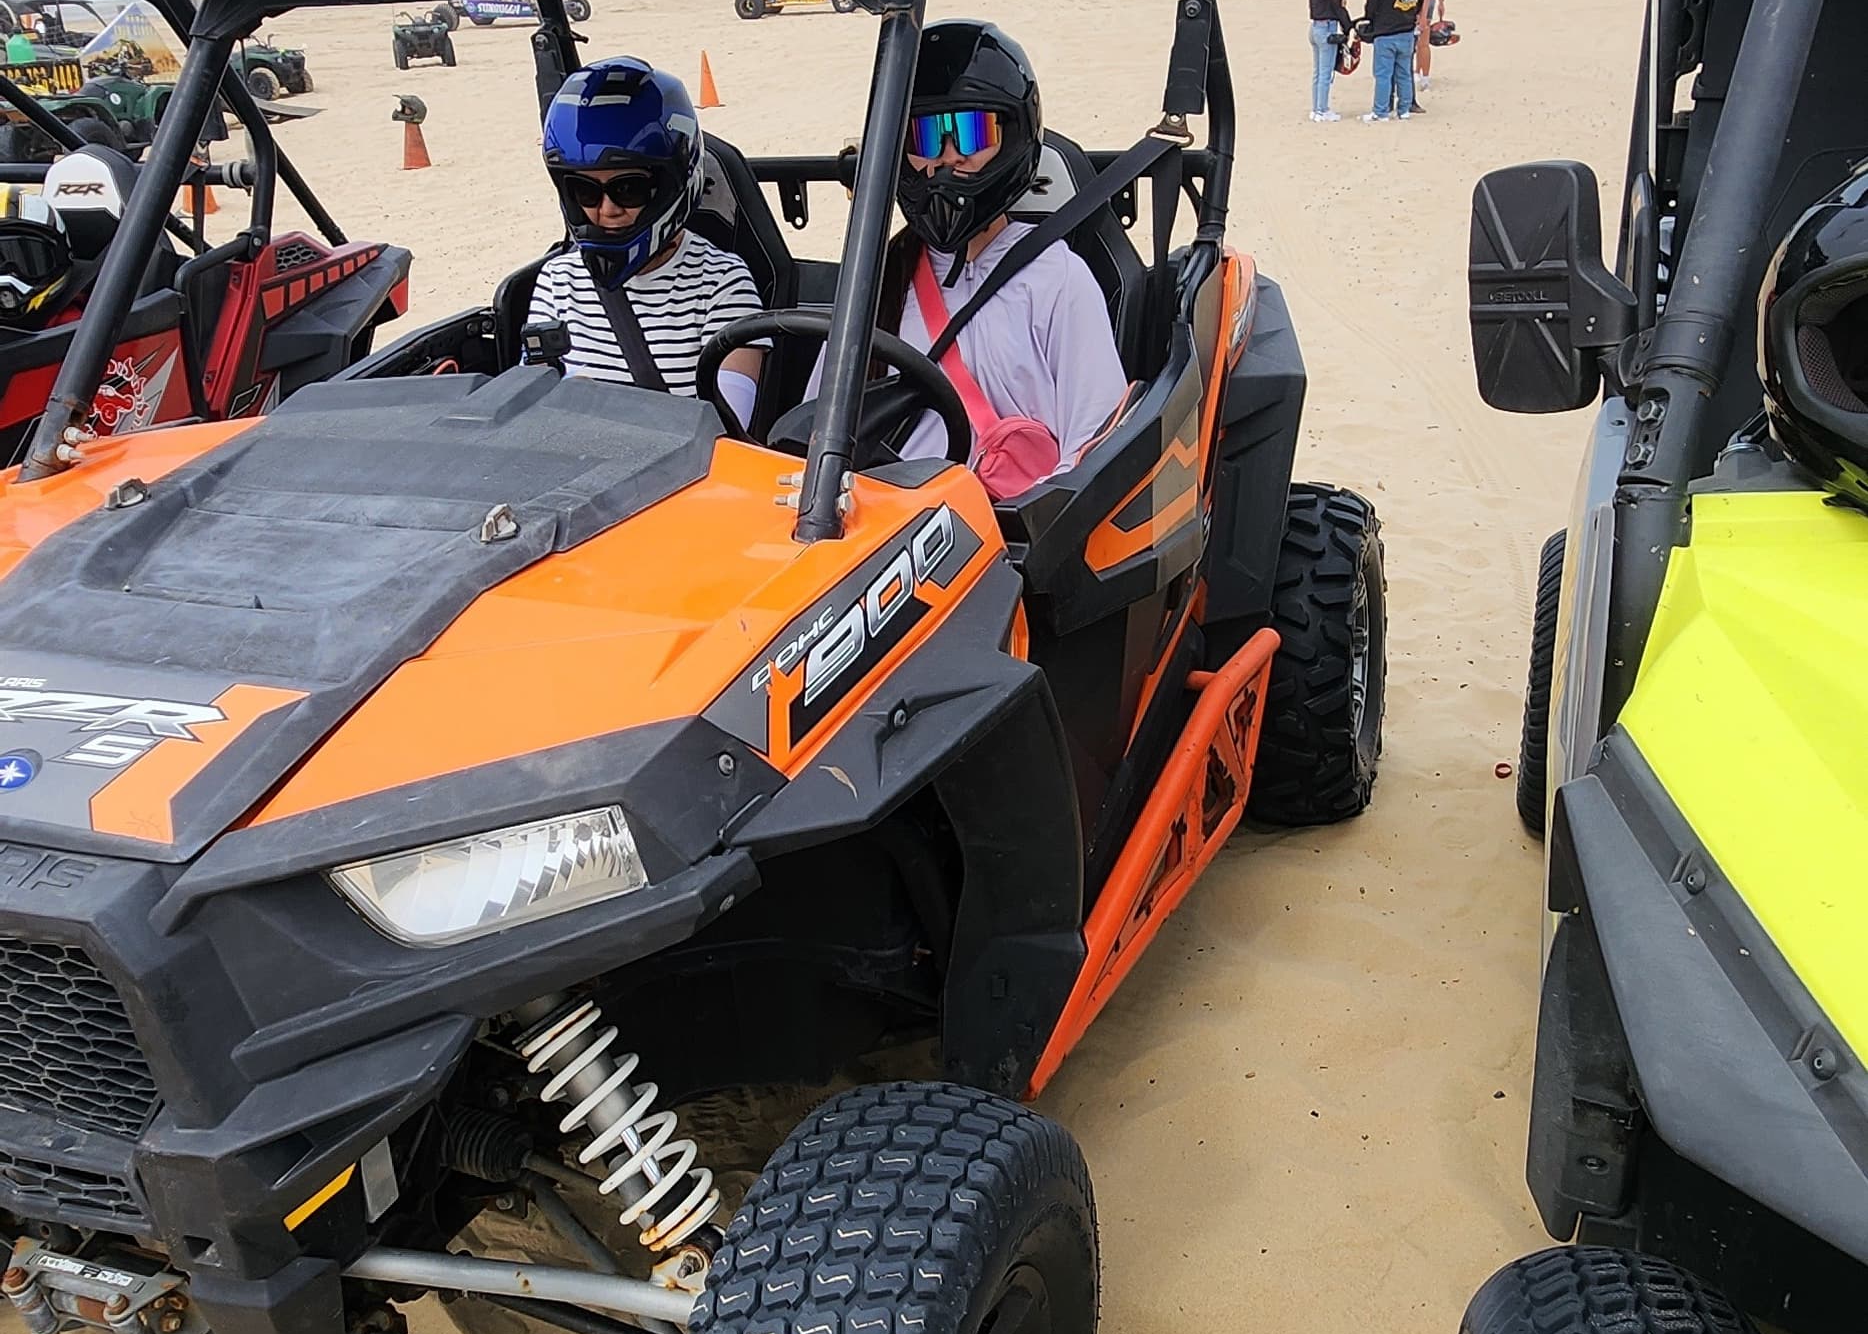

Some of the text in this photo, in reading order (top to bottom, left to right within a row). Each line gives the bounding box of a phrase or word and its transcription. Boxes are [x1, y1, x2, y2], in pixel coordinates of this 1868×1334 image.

[53, 182, 106, 198] RZR
[803, 500, 955, 708] 900
[751, 605, 837, 693] DOHC
[59, 732, 158, 767] S
